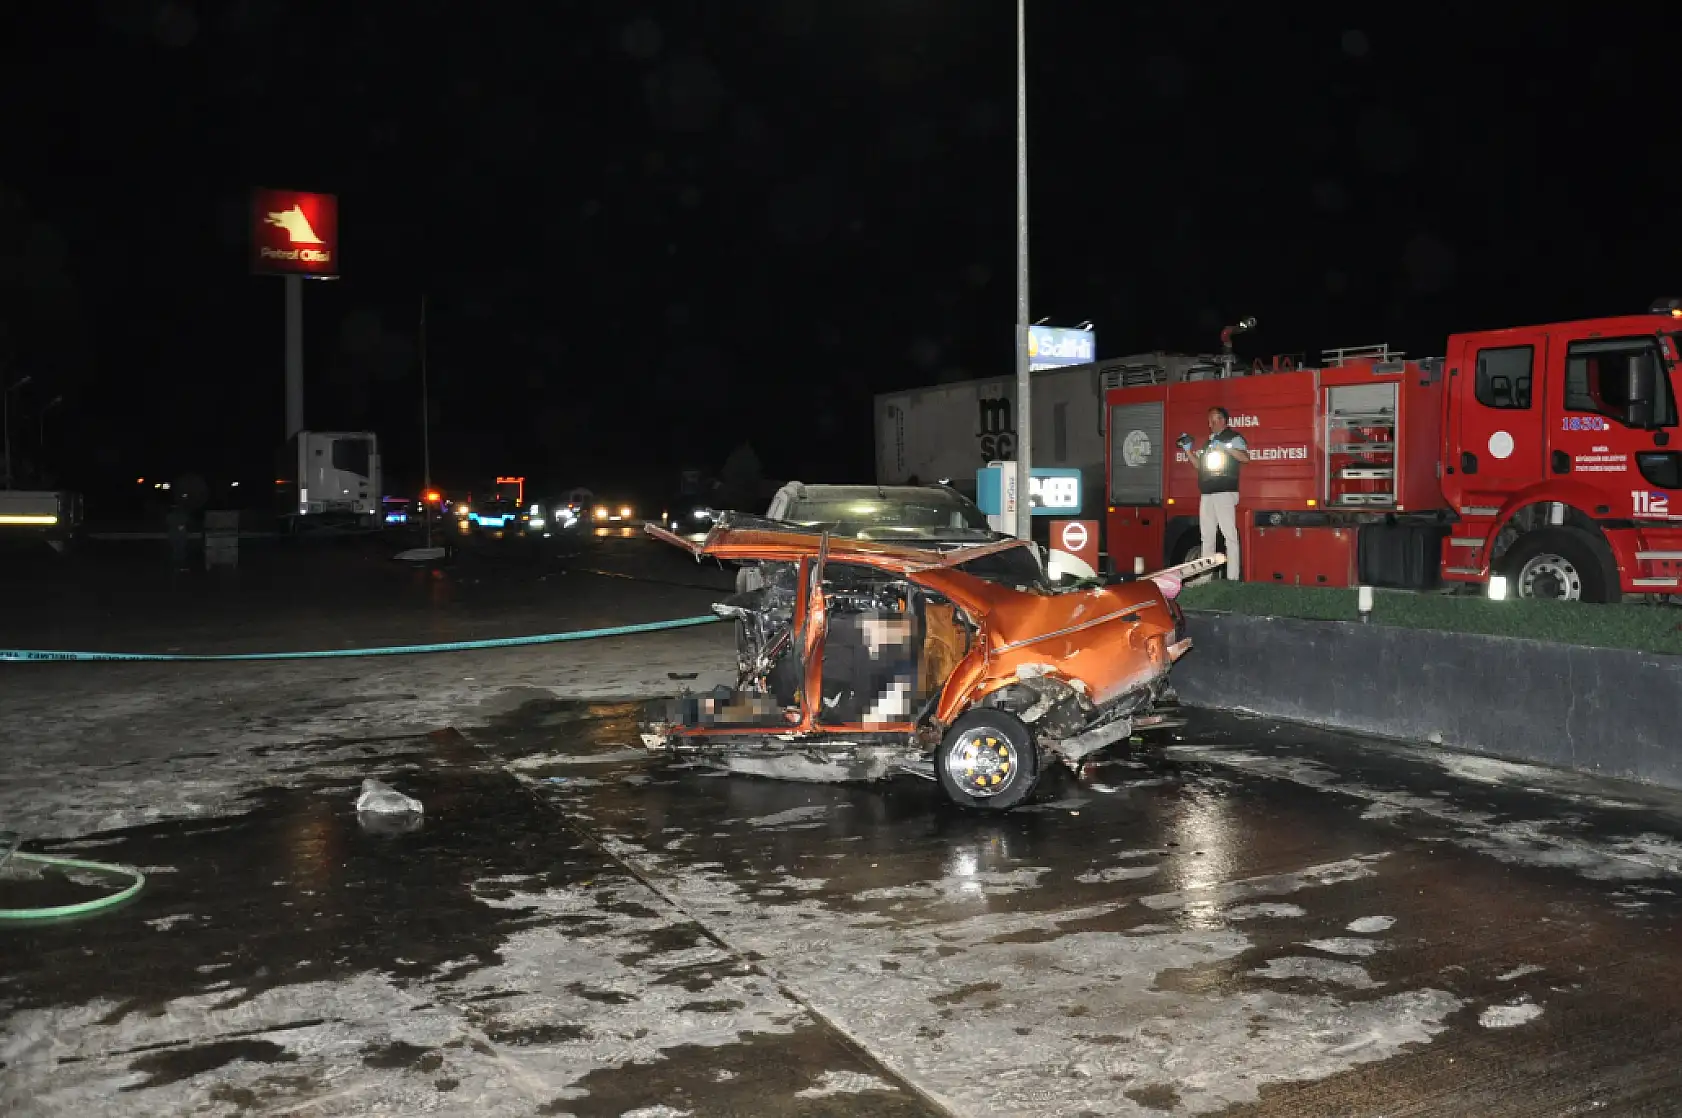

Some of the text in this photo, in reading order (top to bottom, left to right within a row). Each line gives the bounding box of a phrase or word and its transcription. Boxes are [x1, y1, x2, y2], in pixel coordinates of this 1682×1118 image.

[1227, 414, 1260, 428] ANİSA
[1246, 445, 1308, 461] ELEDİYESİ
[1631, 490, 1669, 513] 112
